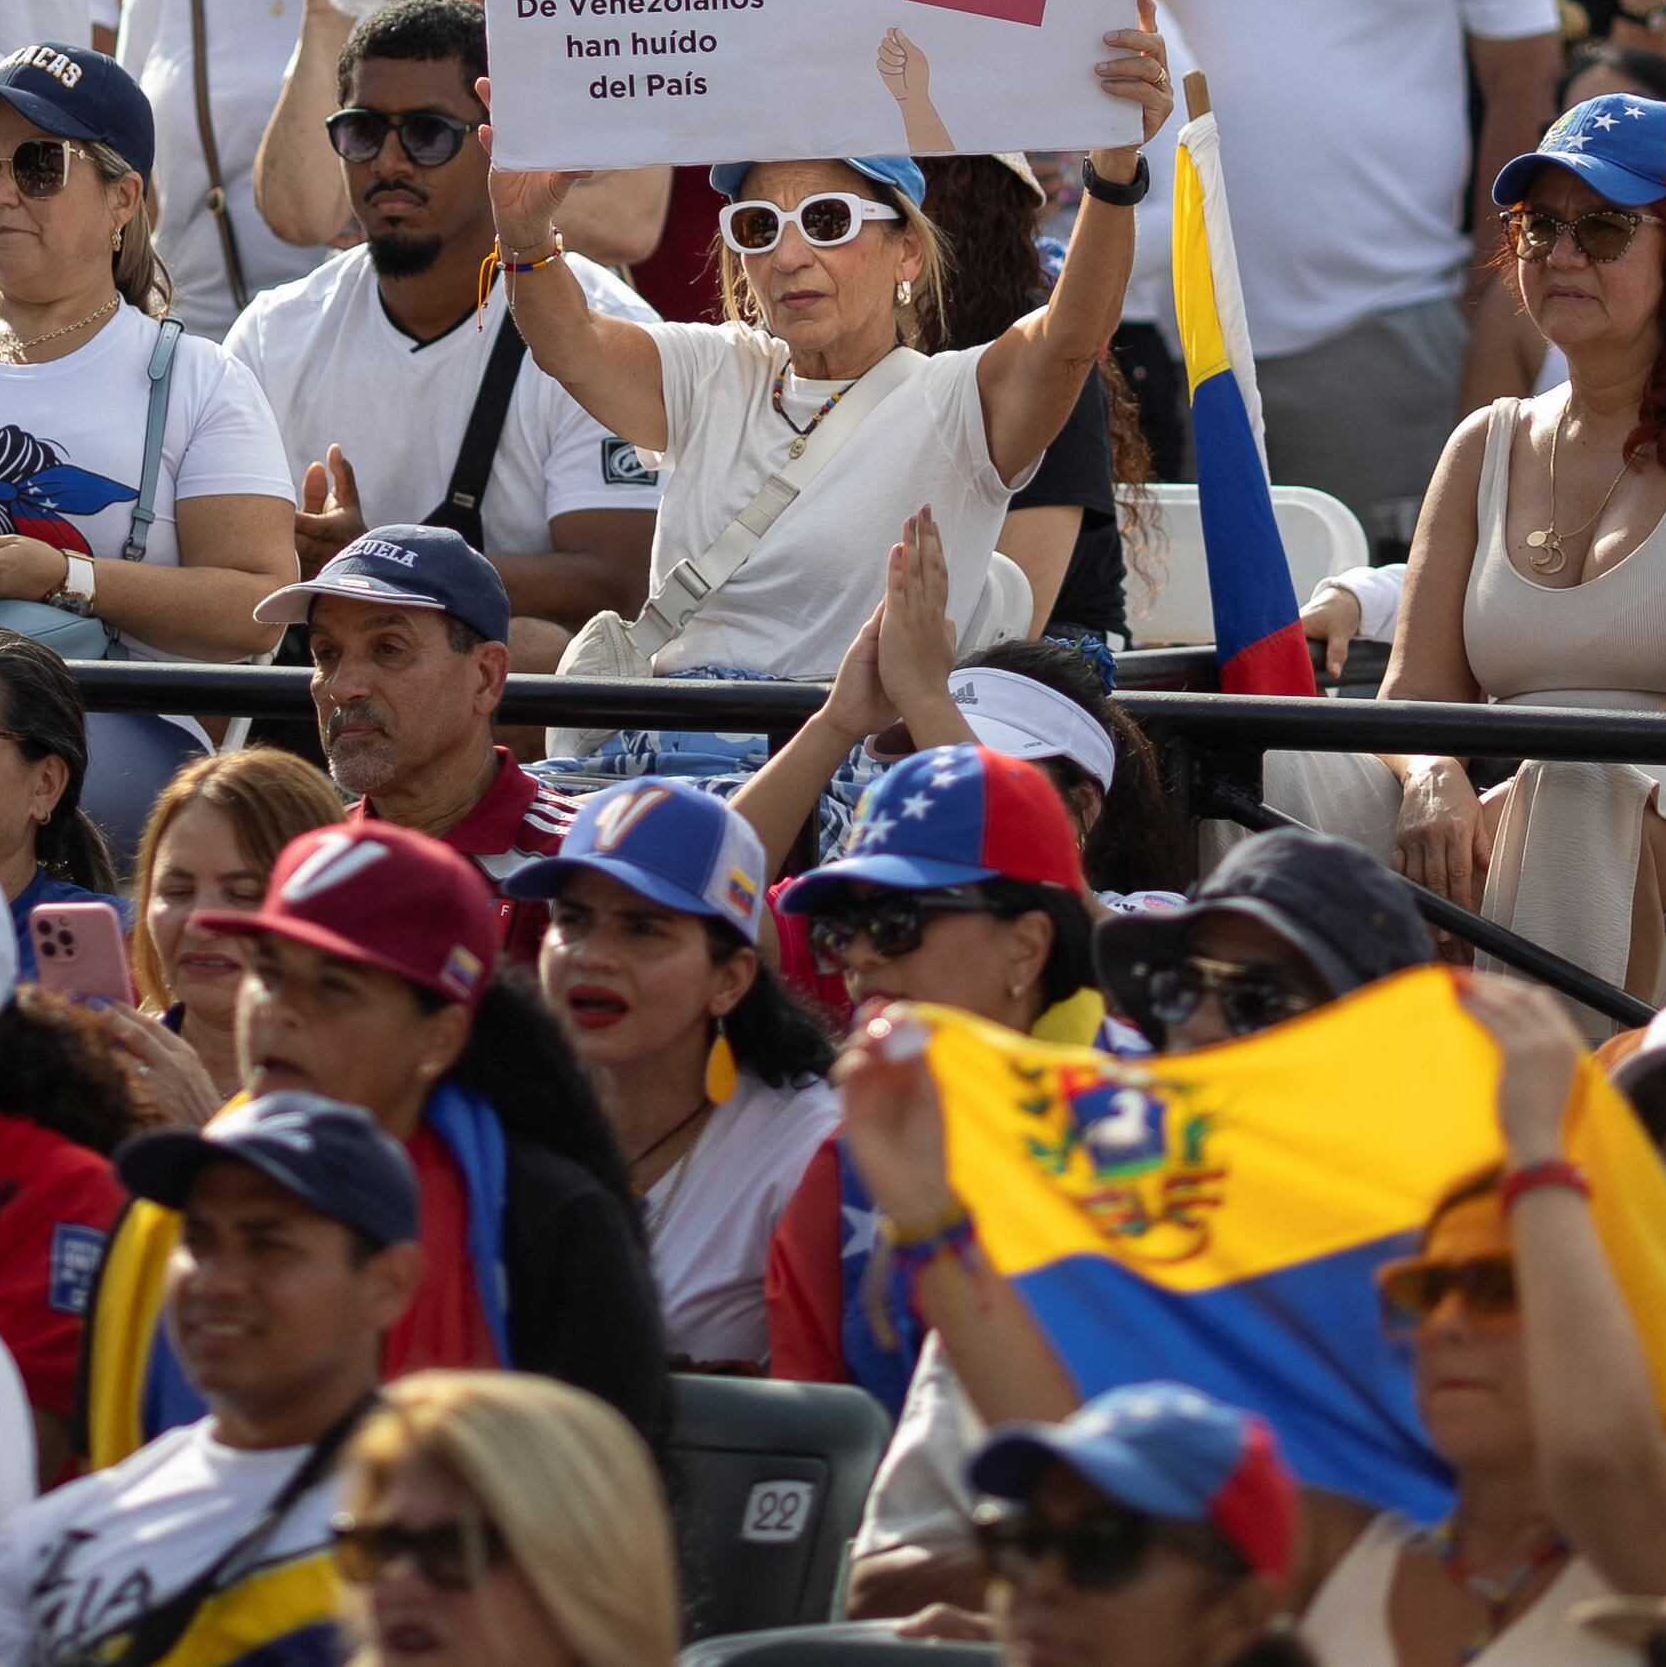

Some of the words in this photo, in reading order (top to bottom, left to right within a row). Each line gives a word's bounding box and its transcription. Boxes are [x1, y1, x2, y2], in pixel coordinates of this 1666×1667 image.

[566, 34, 621, 58] han
[631, 29, 718, 56] huído
[589, 74, 635, 99] del
[646, 70, 708, 97] País
[753, 1490, 801, 1531] 22
